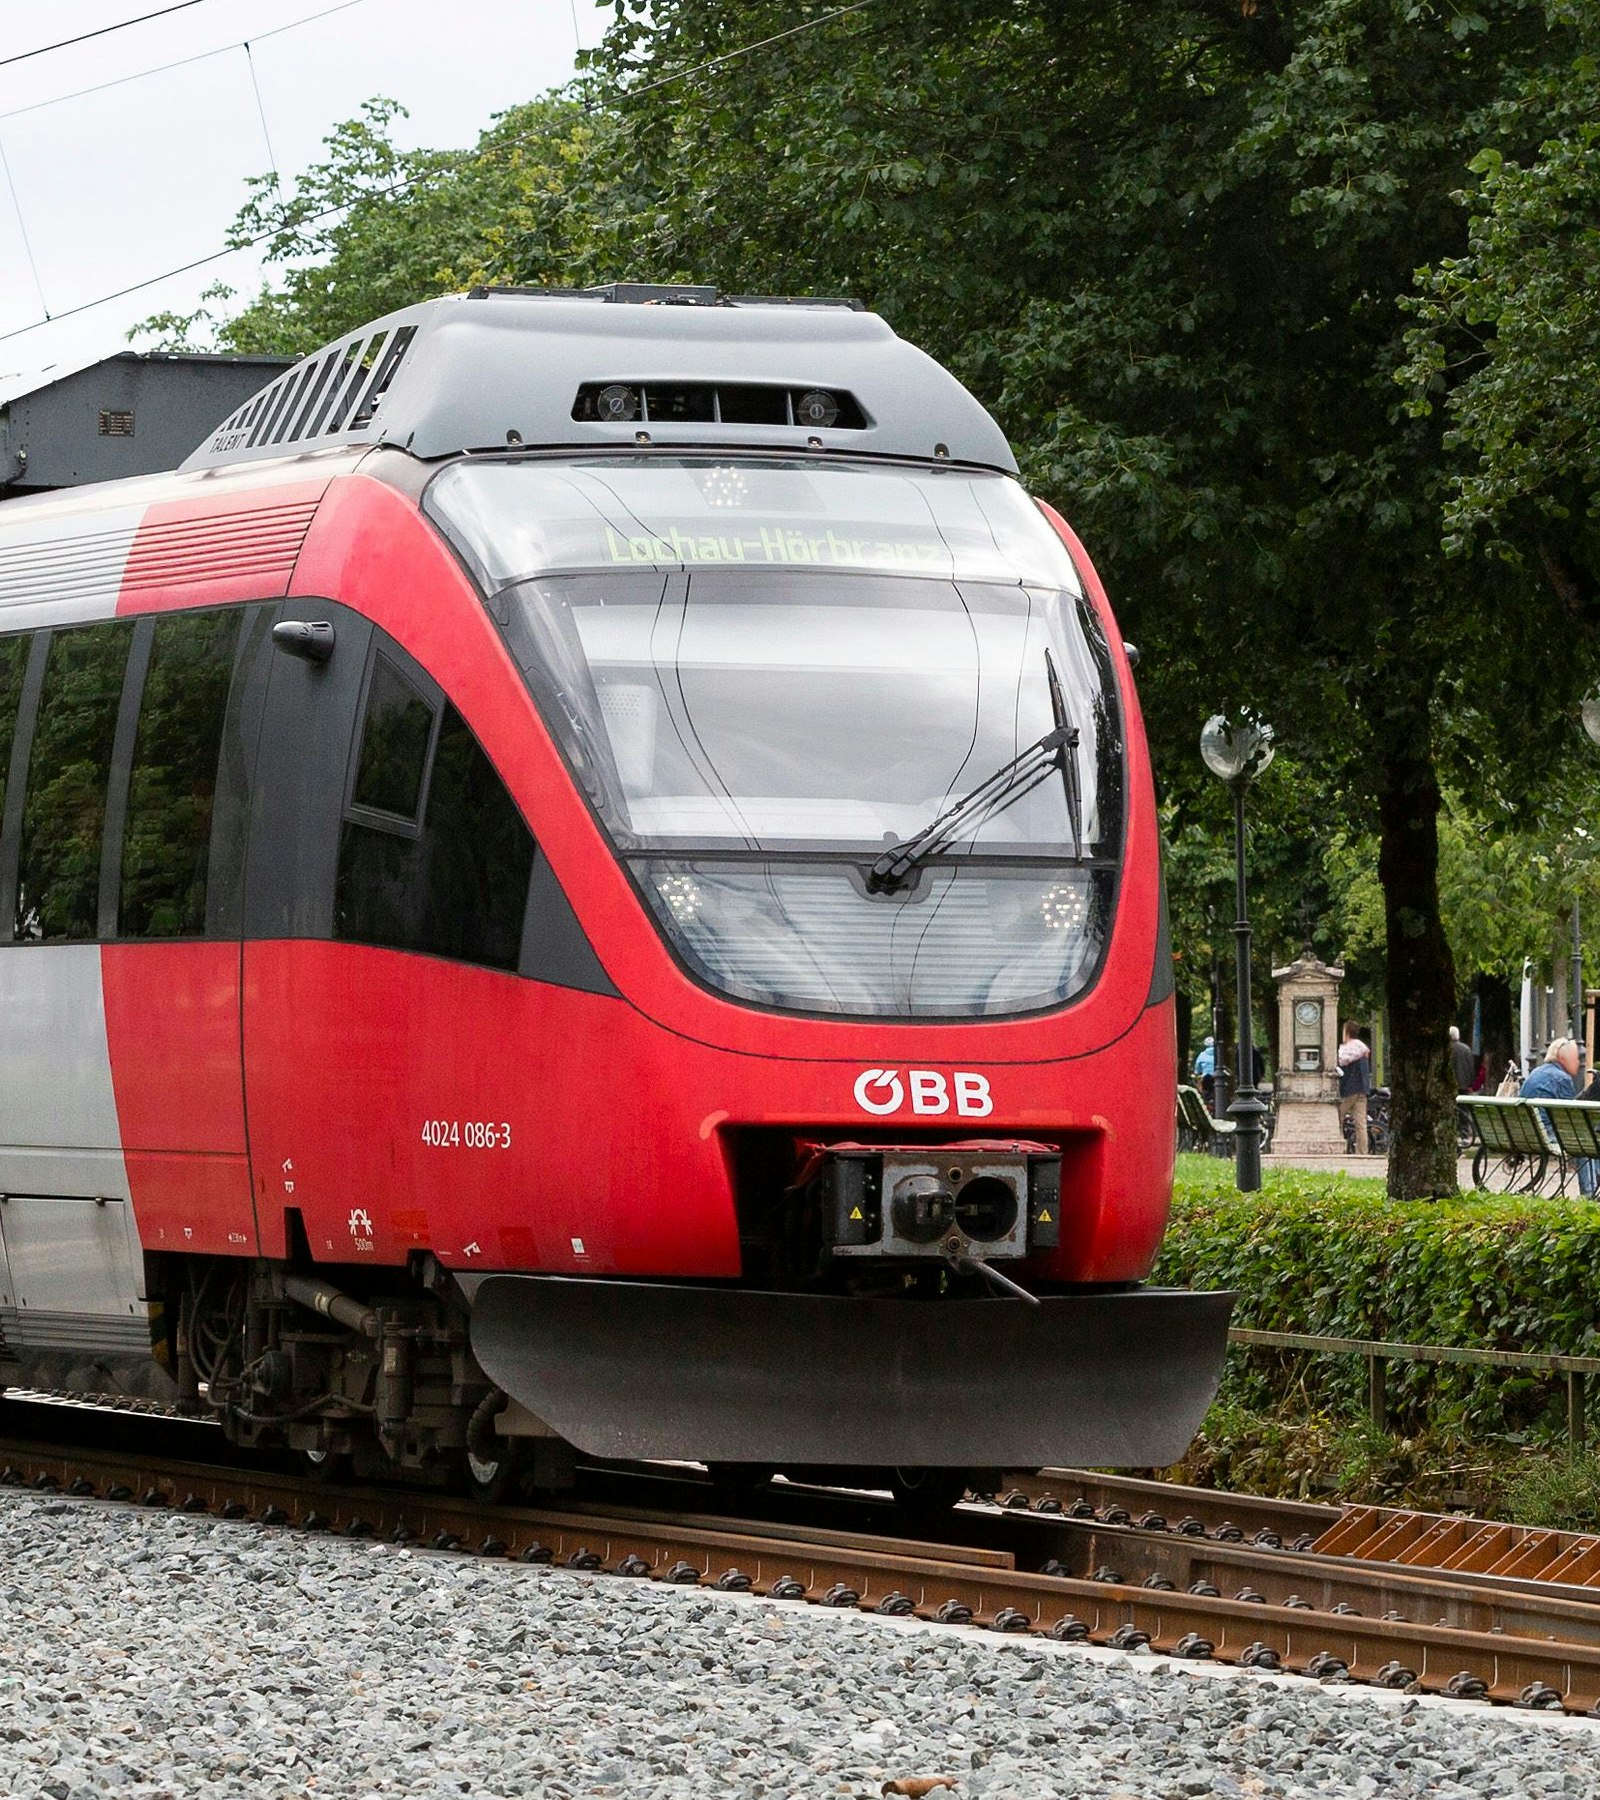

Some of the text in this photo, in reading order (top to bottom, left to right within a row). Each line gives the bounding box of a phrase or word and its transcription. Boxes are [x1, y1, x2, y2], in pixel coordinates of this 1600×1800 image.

[209, 433, 246, 454] TALENT
[605, 527, 941, 562] Lochau-Hörbranz
[853, 1068, 994, 1118] ÖBB
[421, 1119, 512, 1149] 4024 086-3
